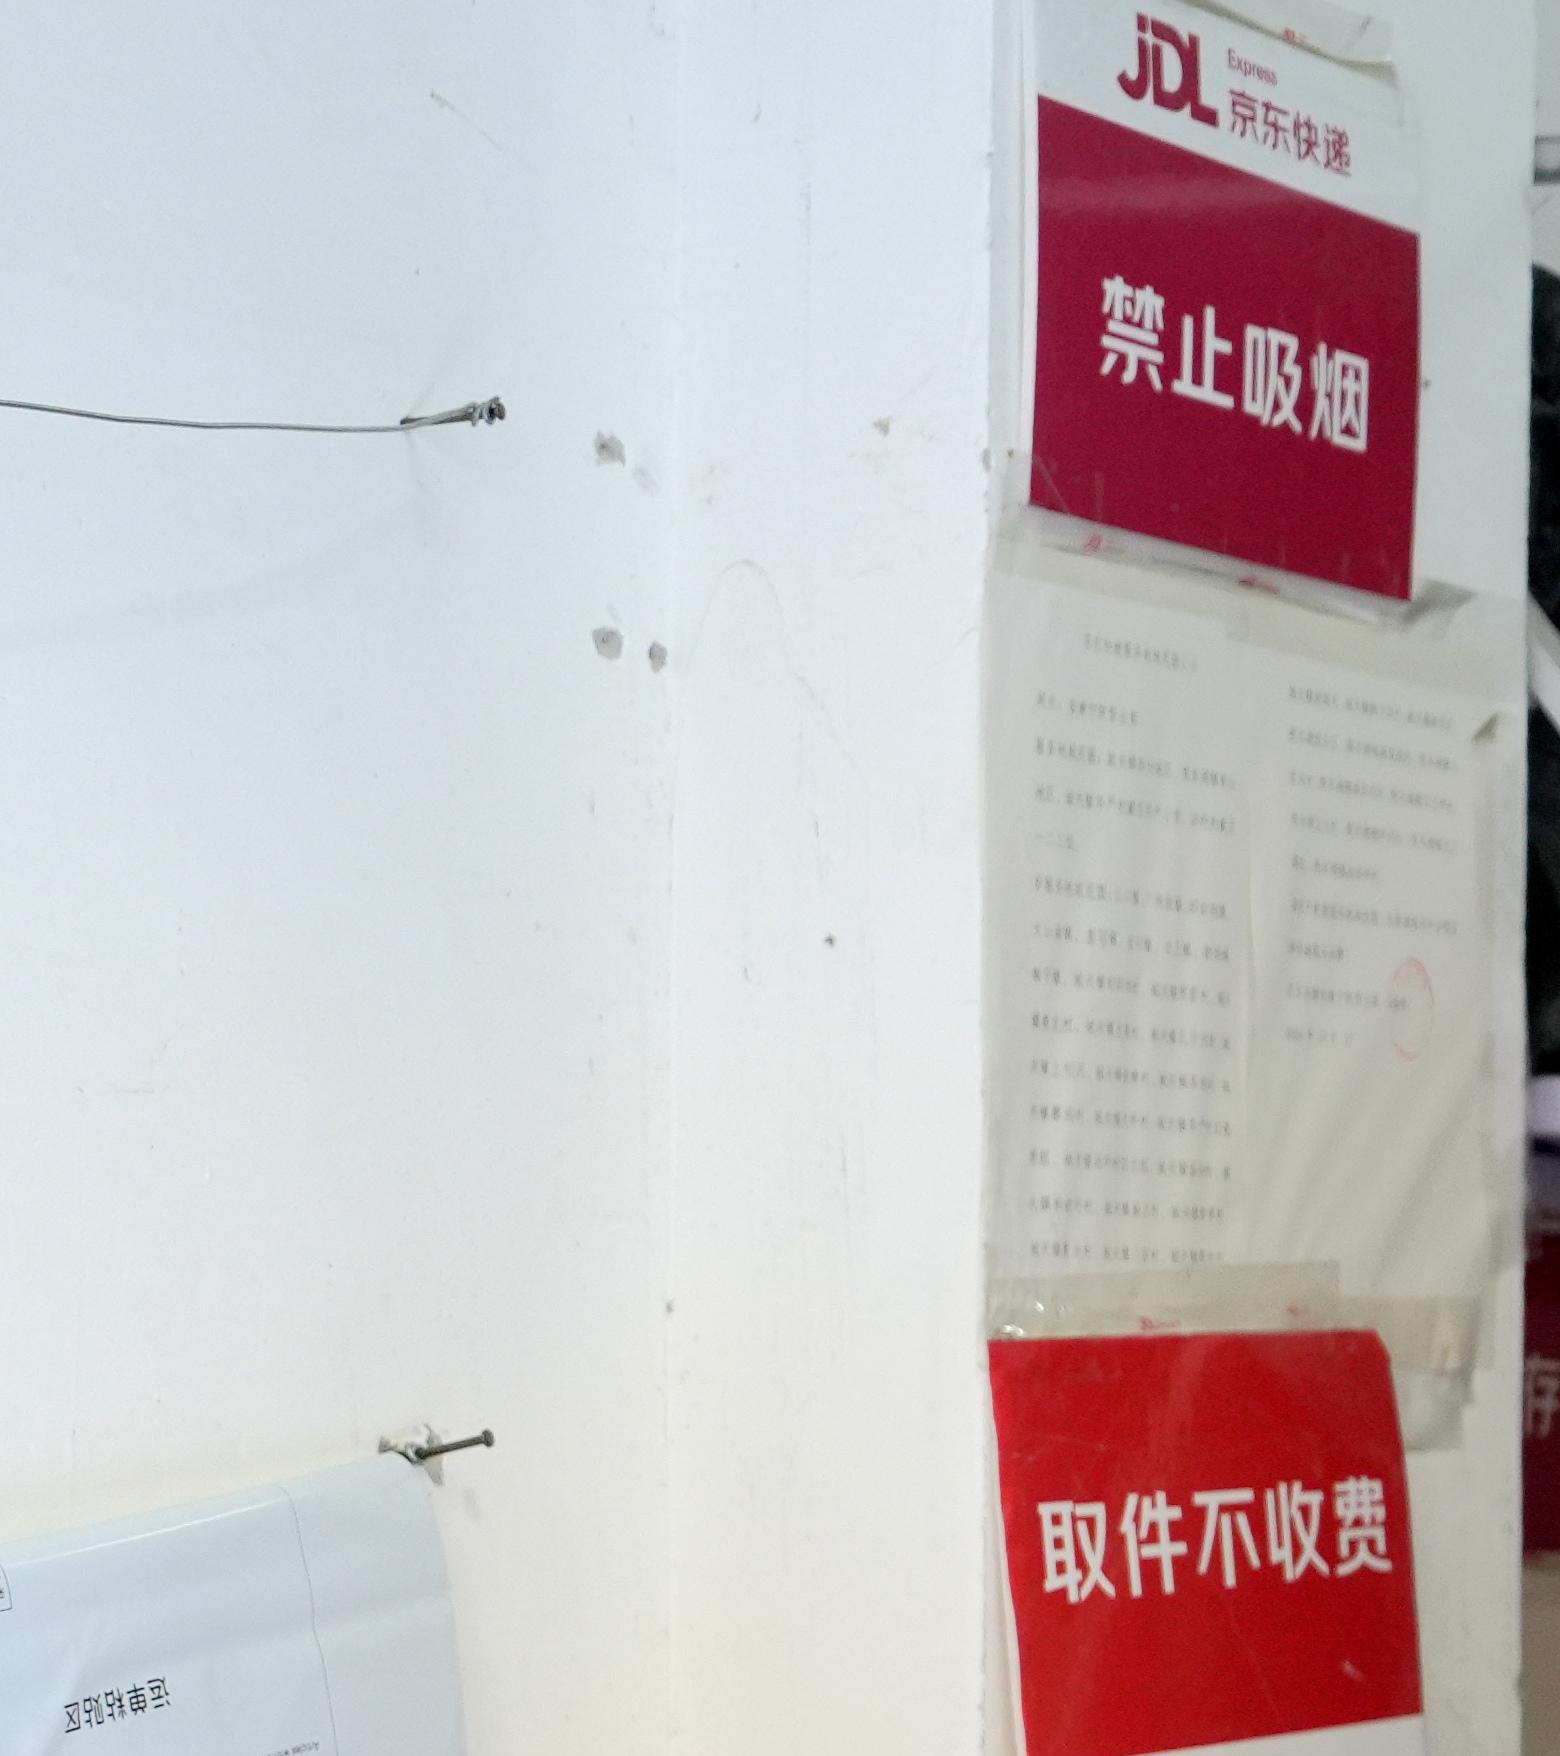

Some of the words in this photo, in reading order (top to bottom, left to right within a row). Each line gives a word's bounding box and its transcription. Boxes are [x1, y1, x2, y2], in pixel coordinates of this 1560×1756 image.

[1117, 11, 1219, 128] JDL
[1227, 48, 1278, 87] Express
[1229, 88, 1351, 177] 京东快递
[1101, 275, 1370, 454] 禁止吸烟
[1037, 1475, 1393, 1604] 取件不收费
[63, 1676, 171, 1734] 运单粘贴区
